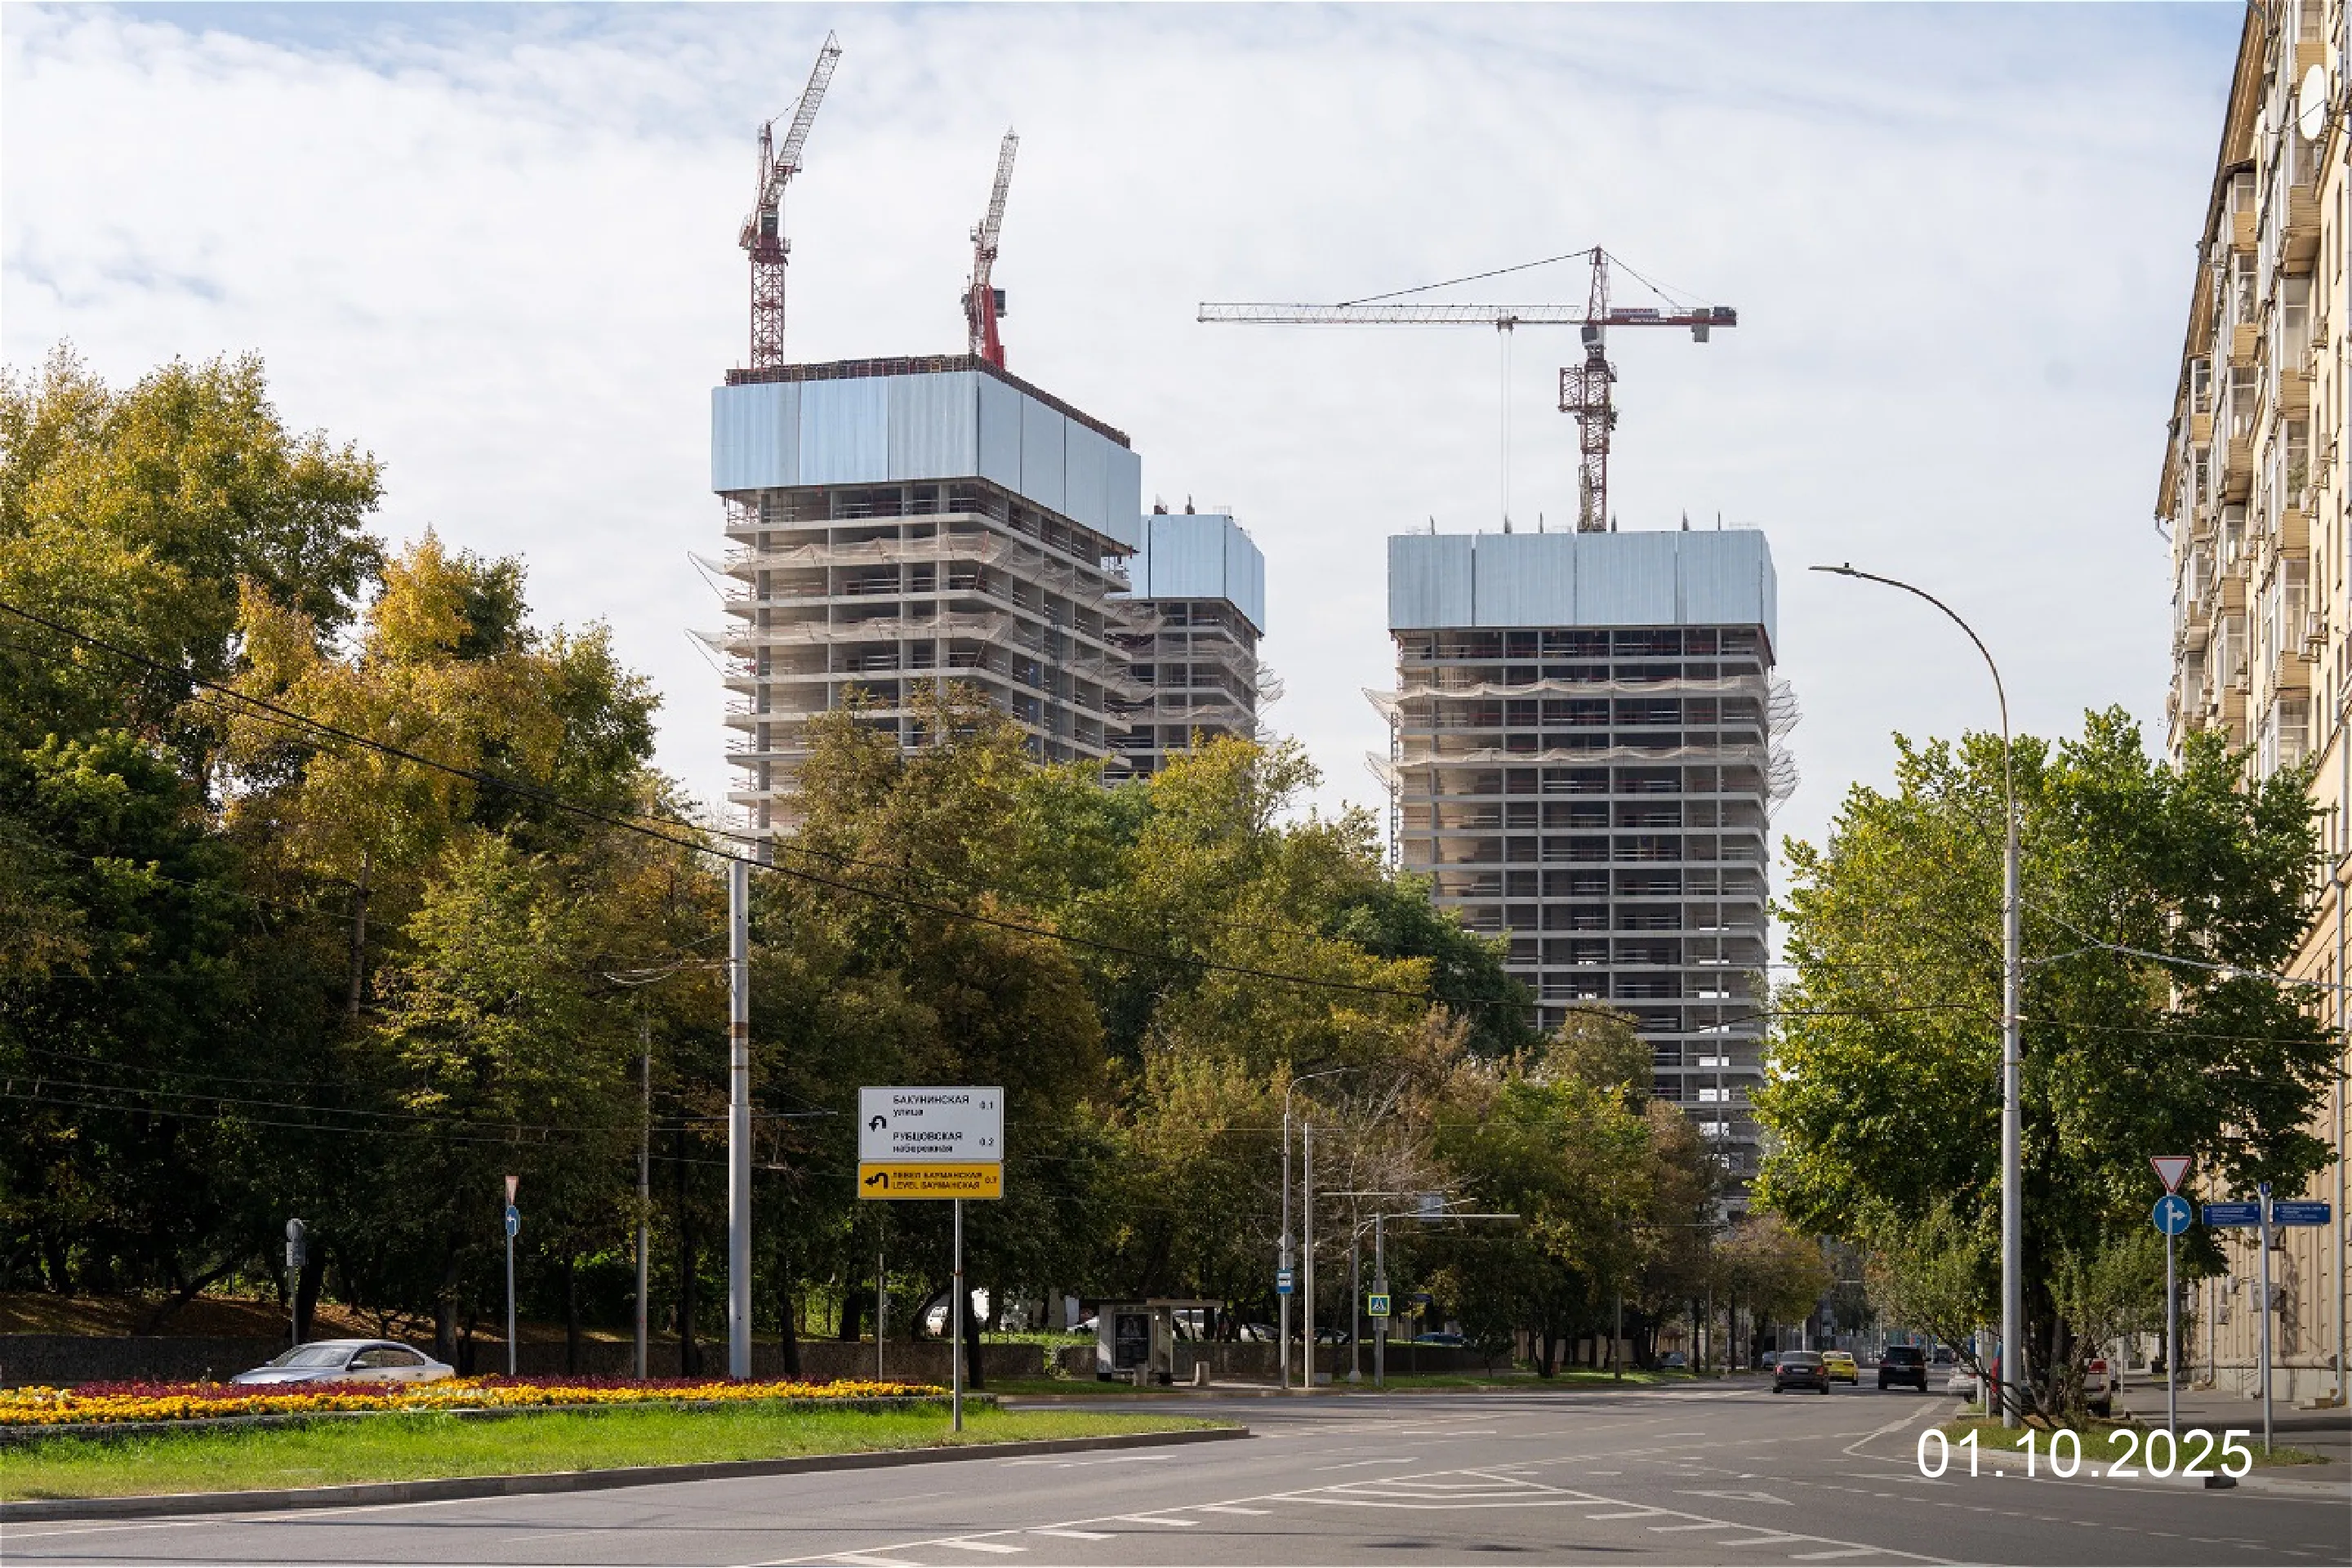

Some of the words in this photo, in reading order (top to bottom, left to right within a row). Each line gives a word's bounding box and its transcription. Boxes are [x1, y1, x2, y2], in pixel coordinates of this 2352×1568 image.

[893, 1094, 969, 1104] БАКУНИНСКАЯ
[978, 1100, 993, 1110] 0.1
[893, 1109, 924, 1117] улица
[893, 1131, 963, 1142] РУБЦОВСКАЯ
[893, 1143, 953, 1154] набережная
